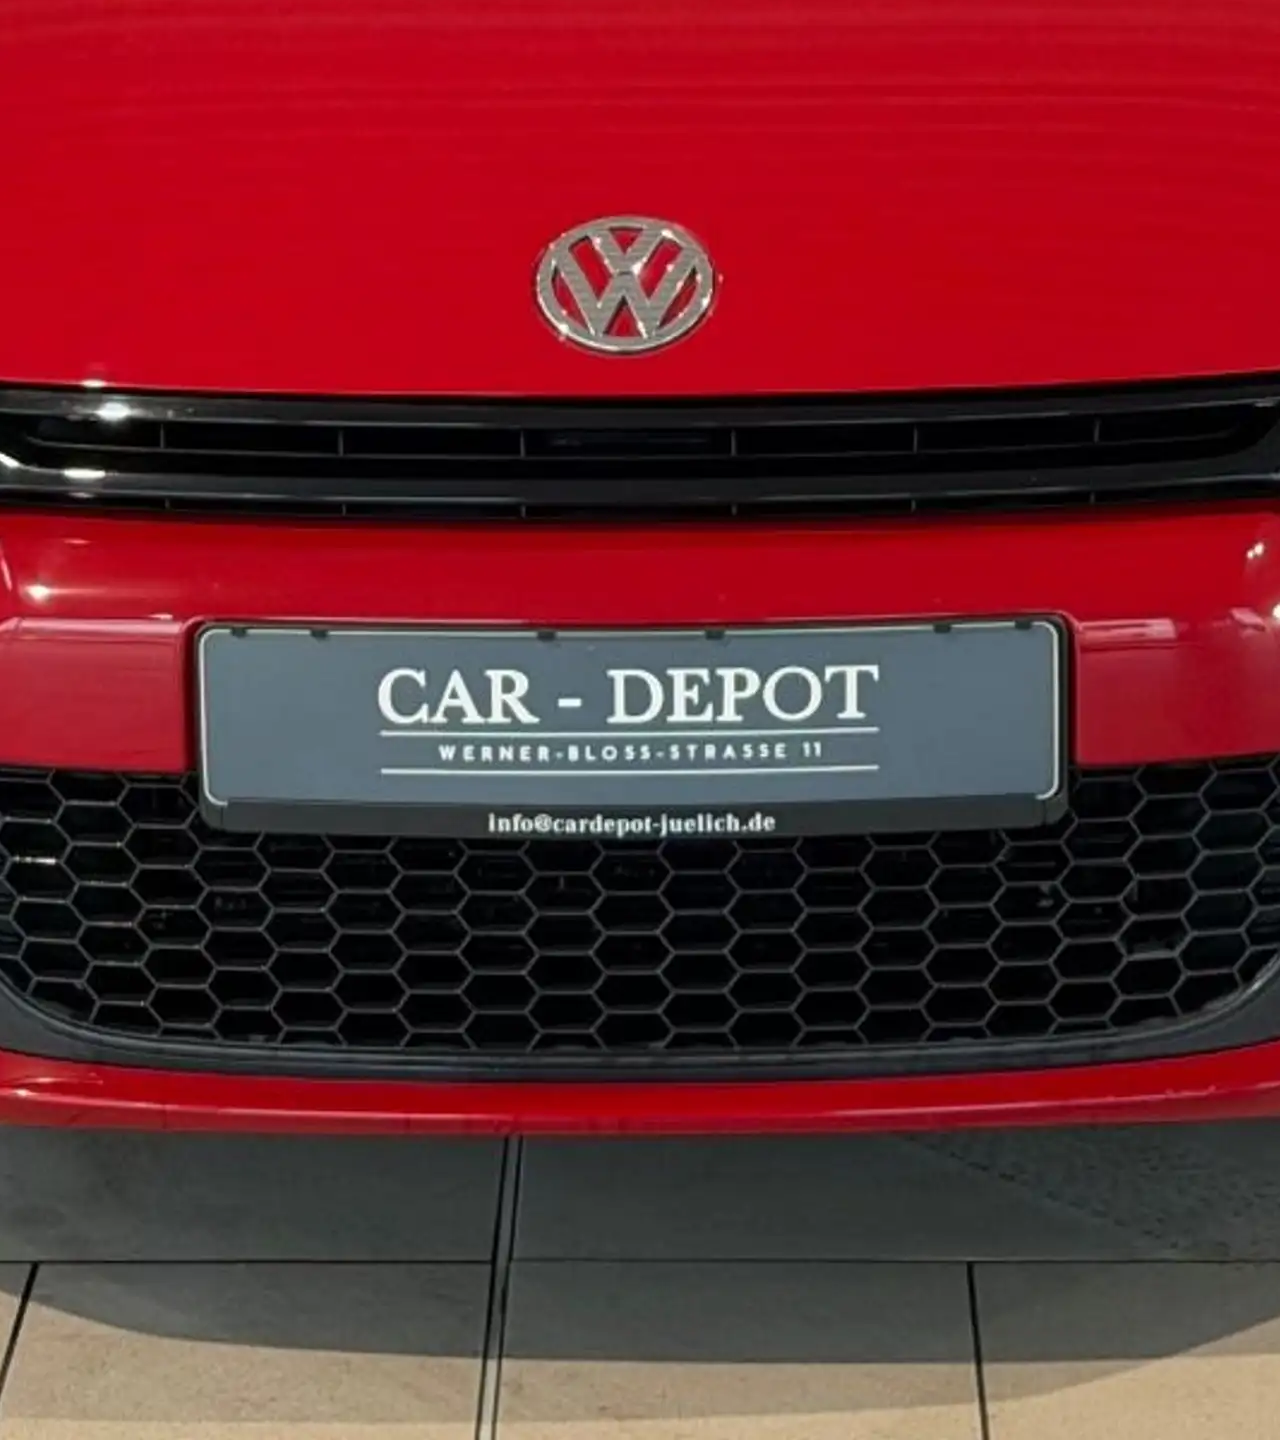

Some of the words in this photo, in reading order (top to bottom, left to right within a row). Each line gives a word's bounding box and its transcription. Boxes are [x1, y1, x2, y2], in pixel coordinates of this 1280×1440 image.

[536, 216, 713, 351] VW
[377, 667, 541, 725] CAR
[605, 664, 880, 725] DEPOT
[437, 742, 788, 762] WERNER-BLOSS-STRASSE
[802, 740, 822, 758] 11
[487, 811, 777, 839] info@cardepot-juelich.de
